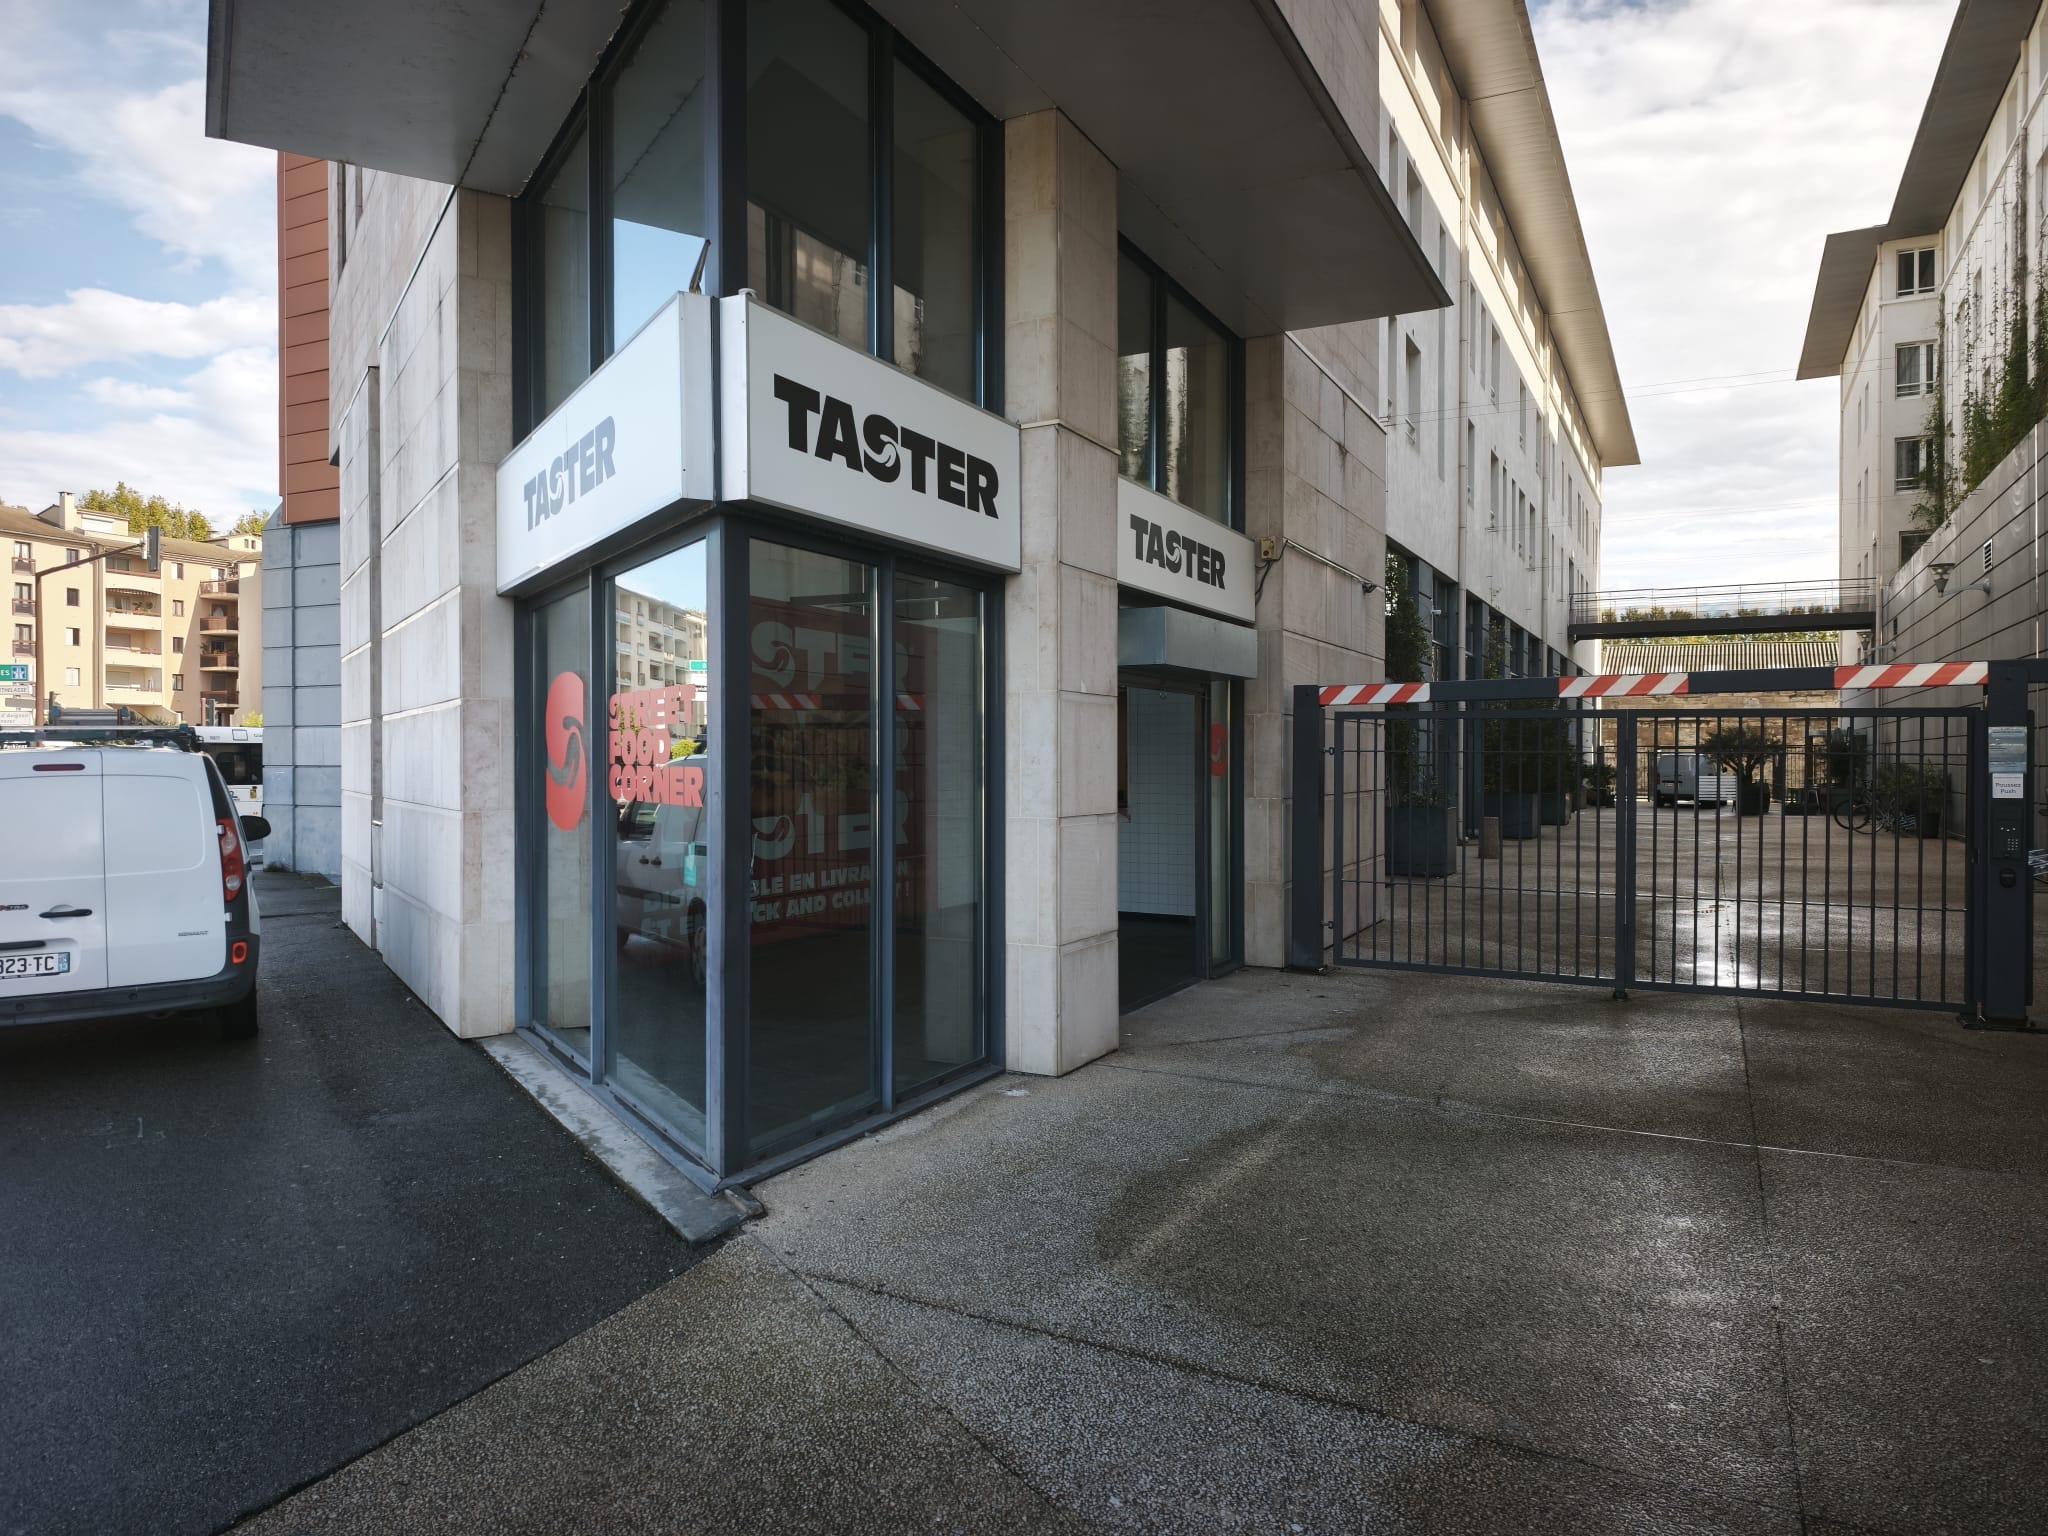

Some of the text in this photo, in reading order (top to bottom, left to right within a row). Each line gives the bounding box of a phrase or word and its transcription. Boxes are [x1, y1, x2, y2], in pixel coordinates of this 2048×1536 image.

[773, 373, 999, 519] TASTER
[523, 416, 616, 532] TASTER
[1130, 514, 1226, 590] TASTER
[609, 684, 697, 730] STREET
[608, 728, 671, 765] FOOD
[608, 763, 704, 808] CORNER
[790, 872, 815, 892] EN
[785, 894, 827, 919] AND
